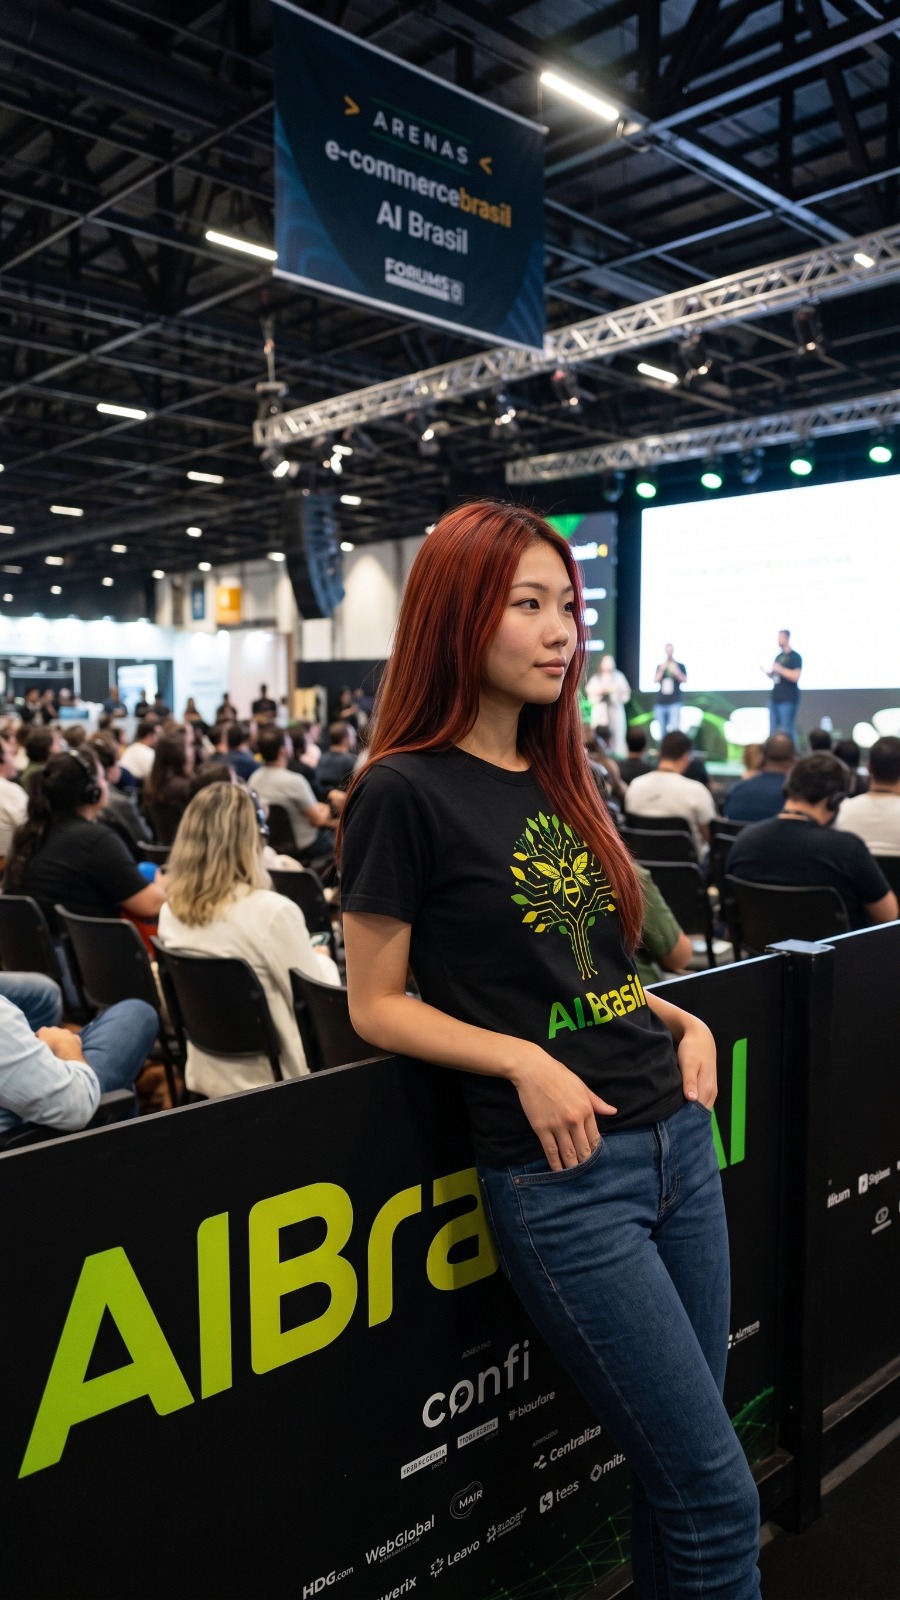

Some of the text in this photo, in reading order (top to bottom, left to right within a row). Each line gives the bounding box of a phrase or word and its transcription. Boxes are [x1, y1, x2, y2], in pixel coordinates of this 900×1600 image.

[373, 111, 468, 165] ARENAS
[325, 139, 512, 228] e-commercebrasil
[376, 201, 468, 255] AI Brasil
[422, 1339, 530, 1428] confi
[549, 1425, 601, 1461] Centraliza
[459, 1489, 483, 1509] MAIR
[365, 1514, 435, 1565] WebGlobal
[447, 1540, 480, 1566] Leavo
[302, 1566, 354, 1600] HDG.com
[377, 1576, 417, 1600] werix
